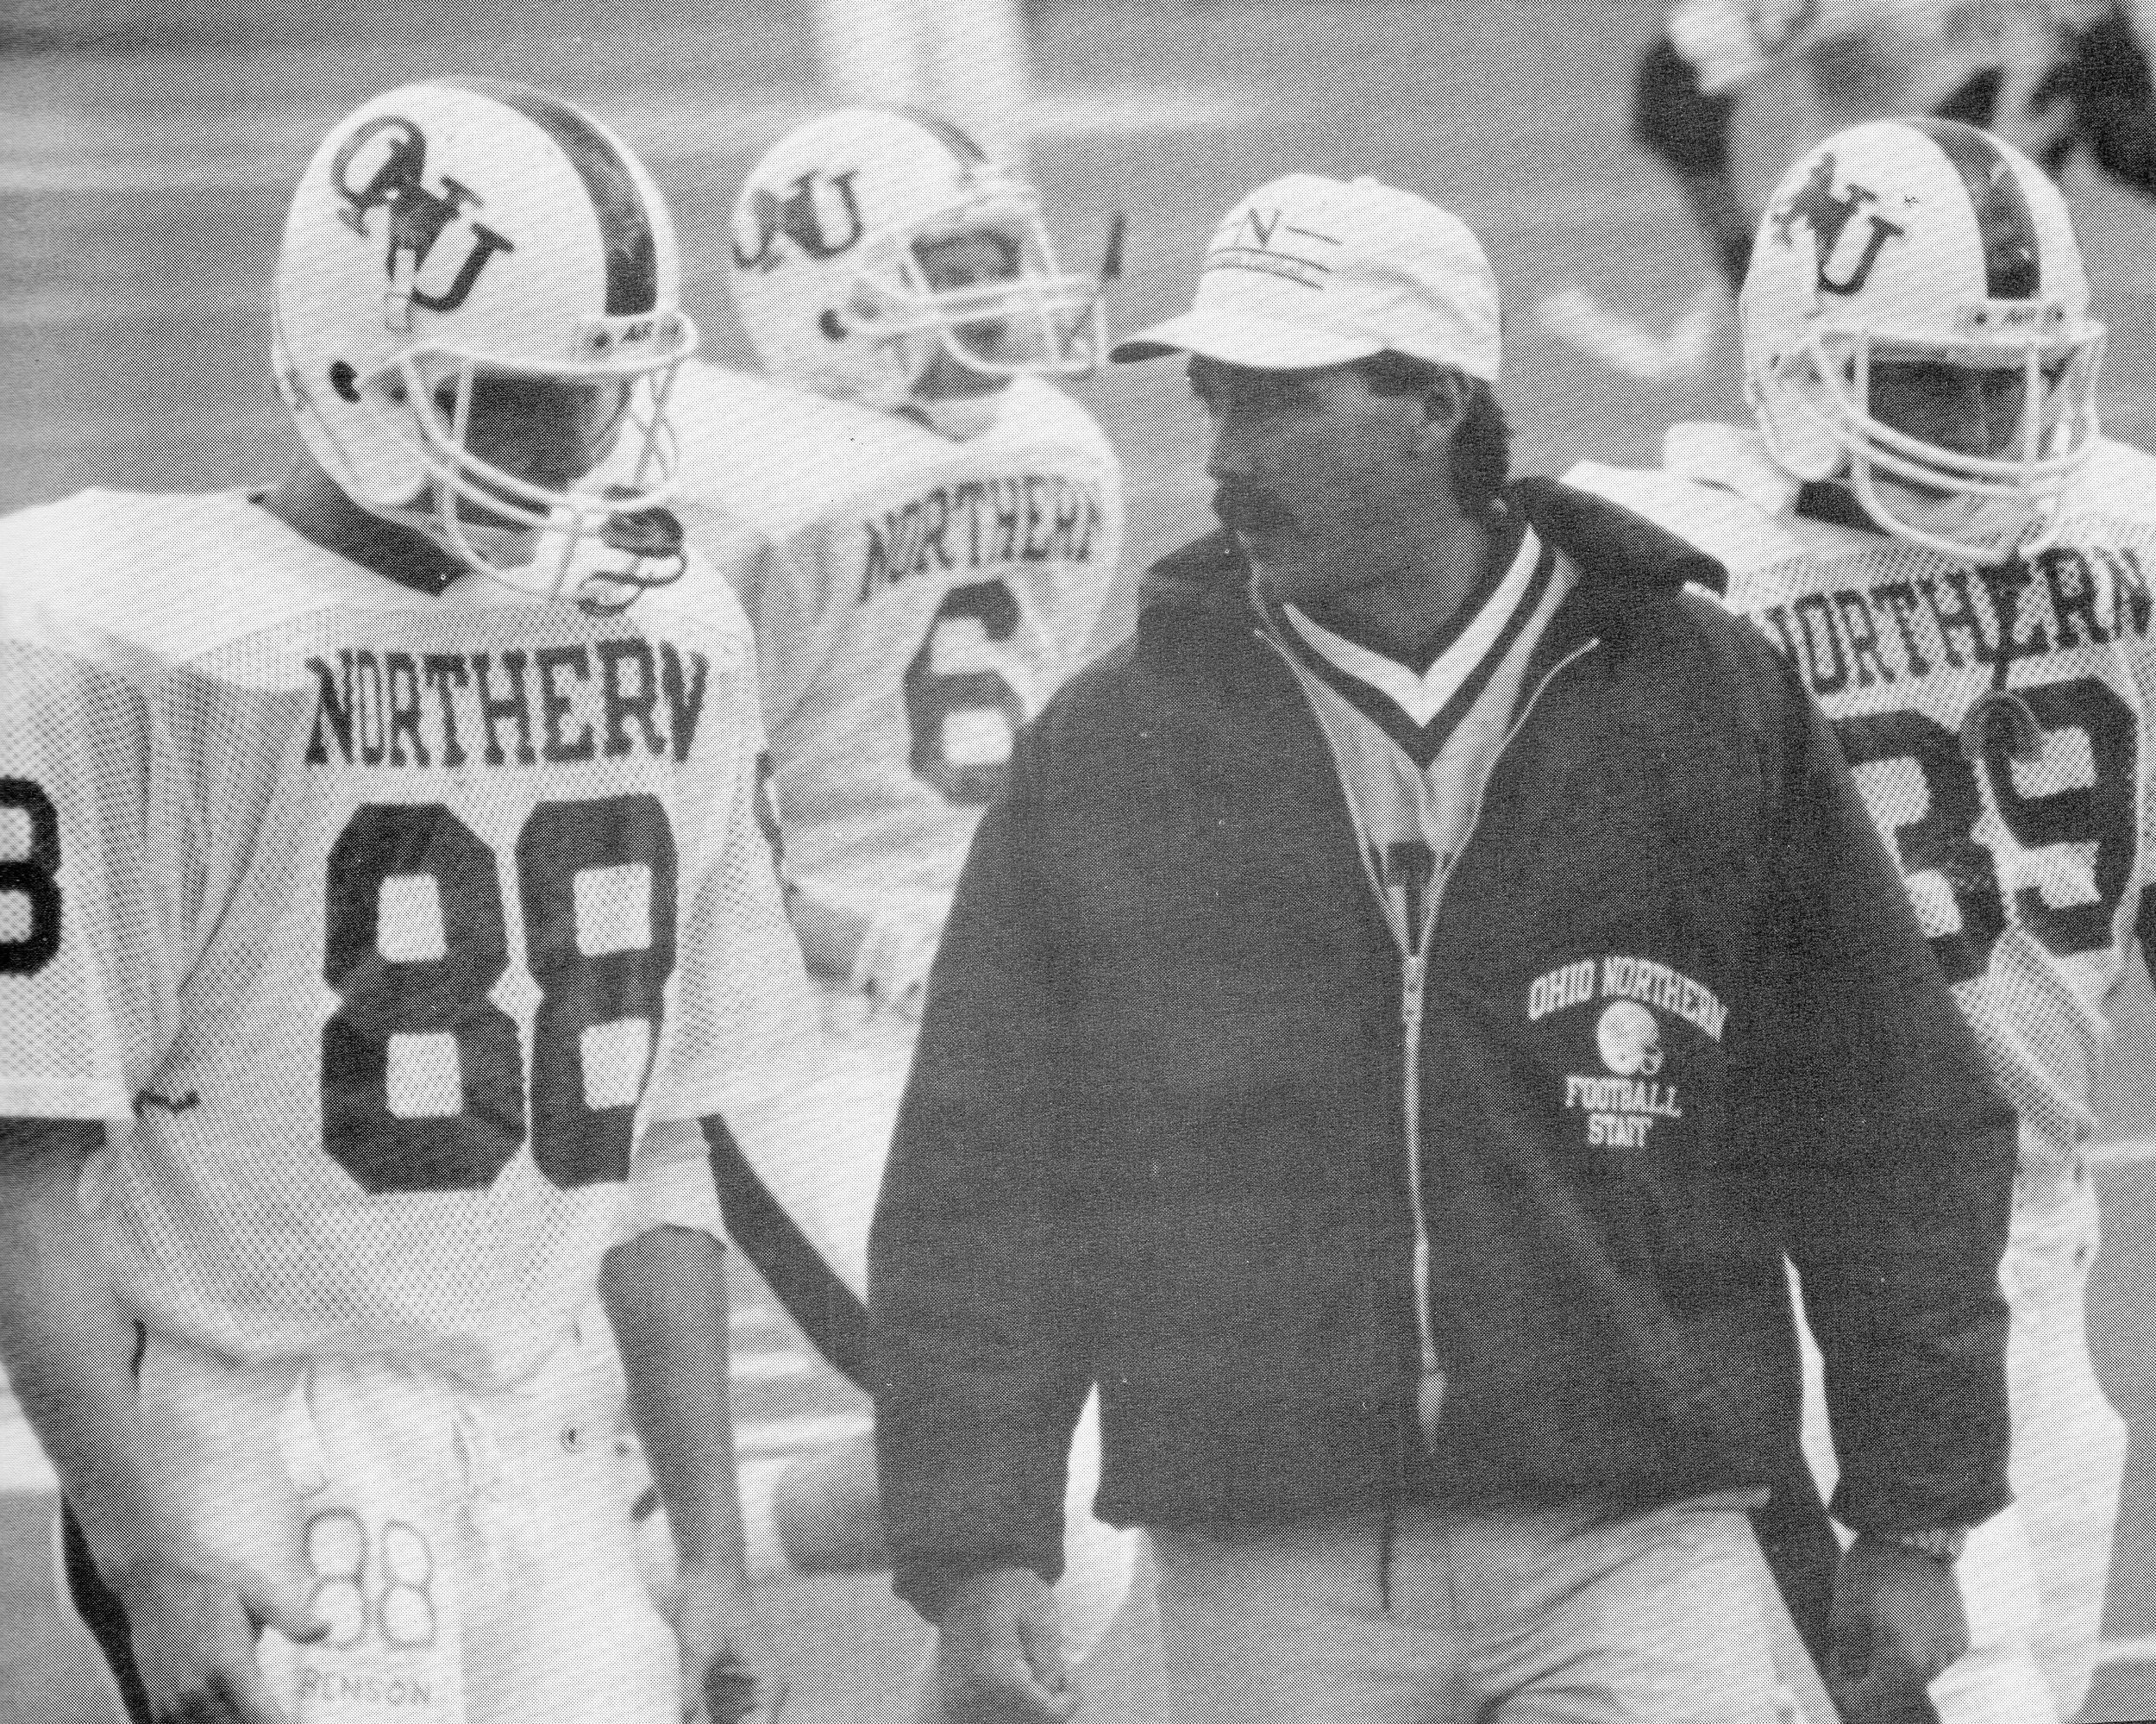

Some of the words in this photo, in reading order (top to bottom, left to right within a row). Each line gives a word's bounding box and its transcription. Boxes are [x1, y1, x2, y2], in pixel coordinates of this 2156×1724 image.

[903, 579, 1022, 806] 6
[320, 793, 680, 1194] 88
[1527, 957, 1595, 1022] OHIO
[1601, 955, 1728, 1042] NORTHERN
[1564, 1075, 1683, 1119] FOOTBALL
